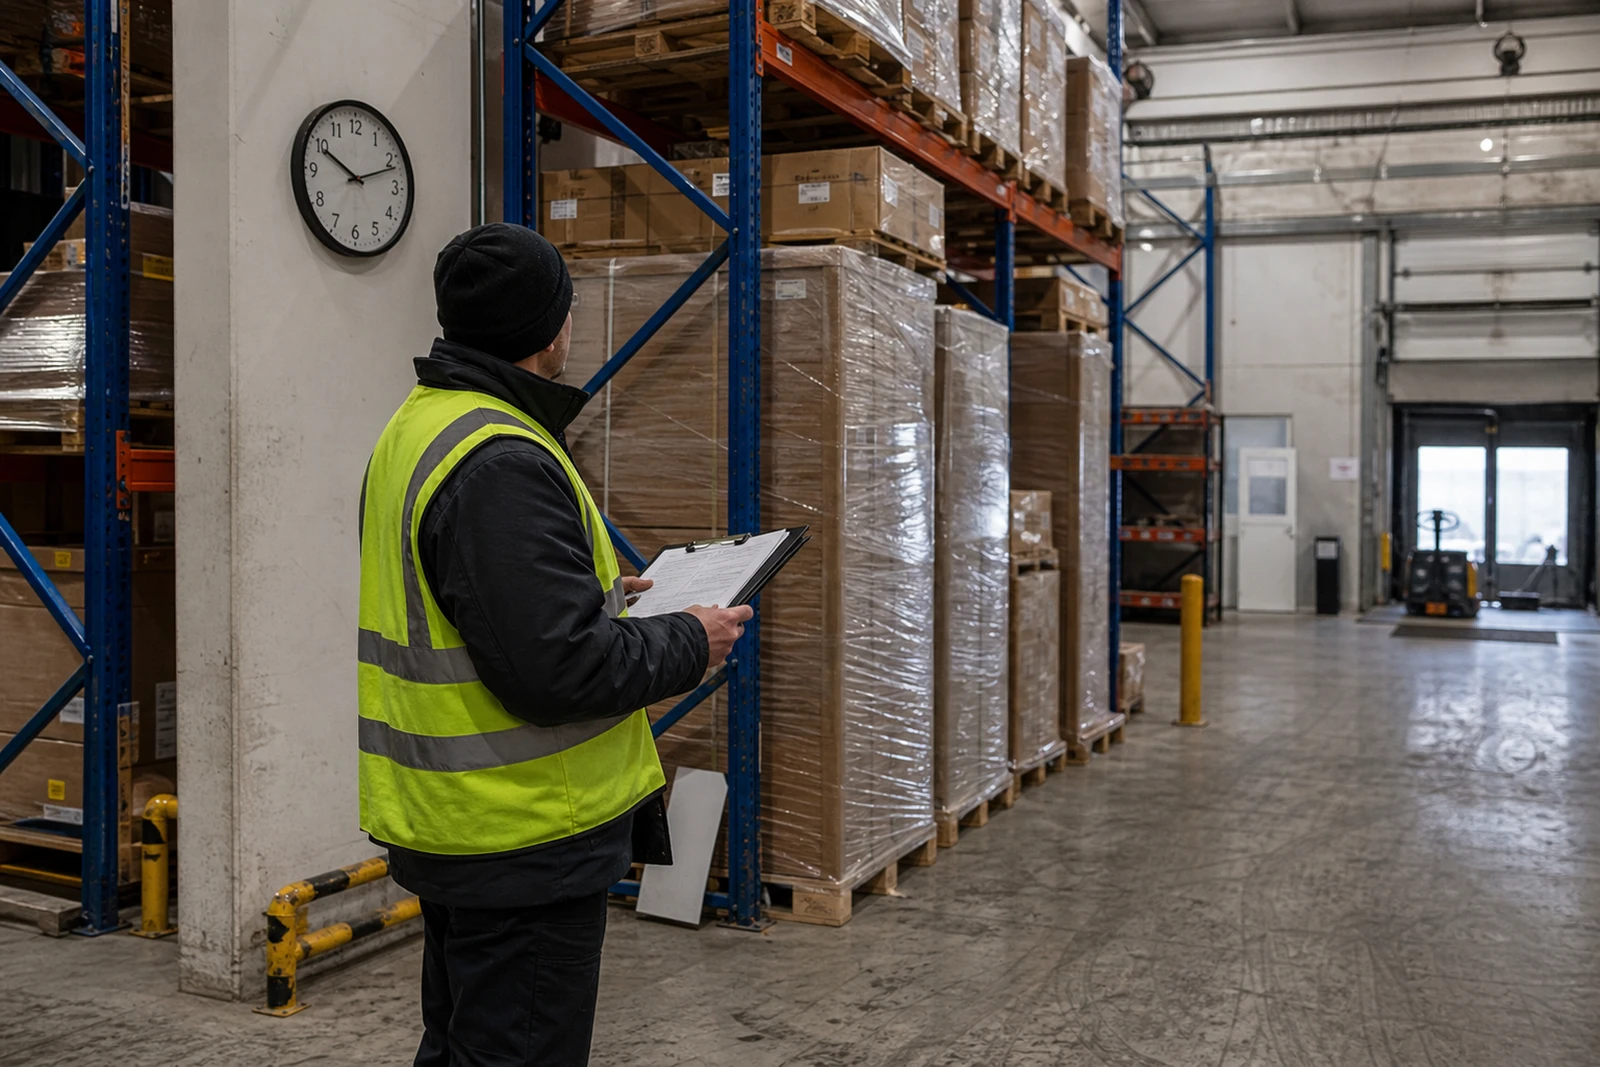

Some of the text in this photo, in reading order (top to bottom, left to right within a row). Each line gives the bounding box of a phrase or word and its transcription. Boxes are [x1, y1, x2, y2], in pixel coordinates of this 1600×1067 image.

[331, 122, 342, 138] 11
[350, 119, 362, 136] 12
[316, 138, 328, 154] 10
[373, 132, 378, 147] 1
[386, 152, 394, 168] 2
[310, 162, 318, 178] 9
[392, 180, 399, 196] 3
[316, 190, 324, 207] 8
[332, 213, 340, 228] 7
[385, 206, 392, 220] 4
[352, 224, 360, 240] 6
[372, 222, 379, 236] 5
